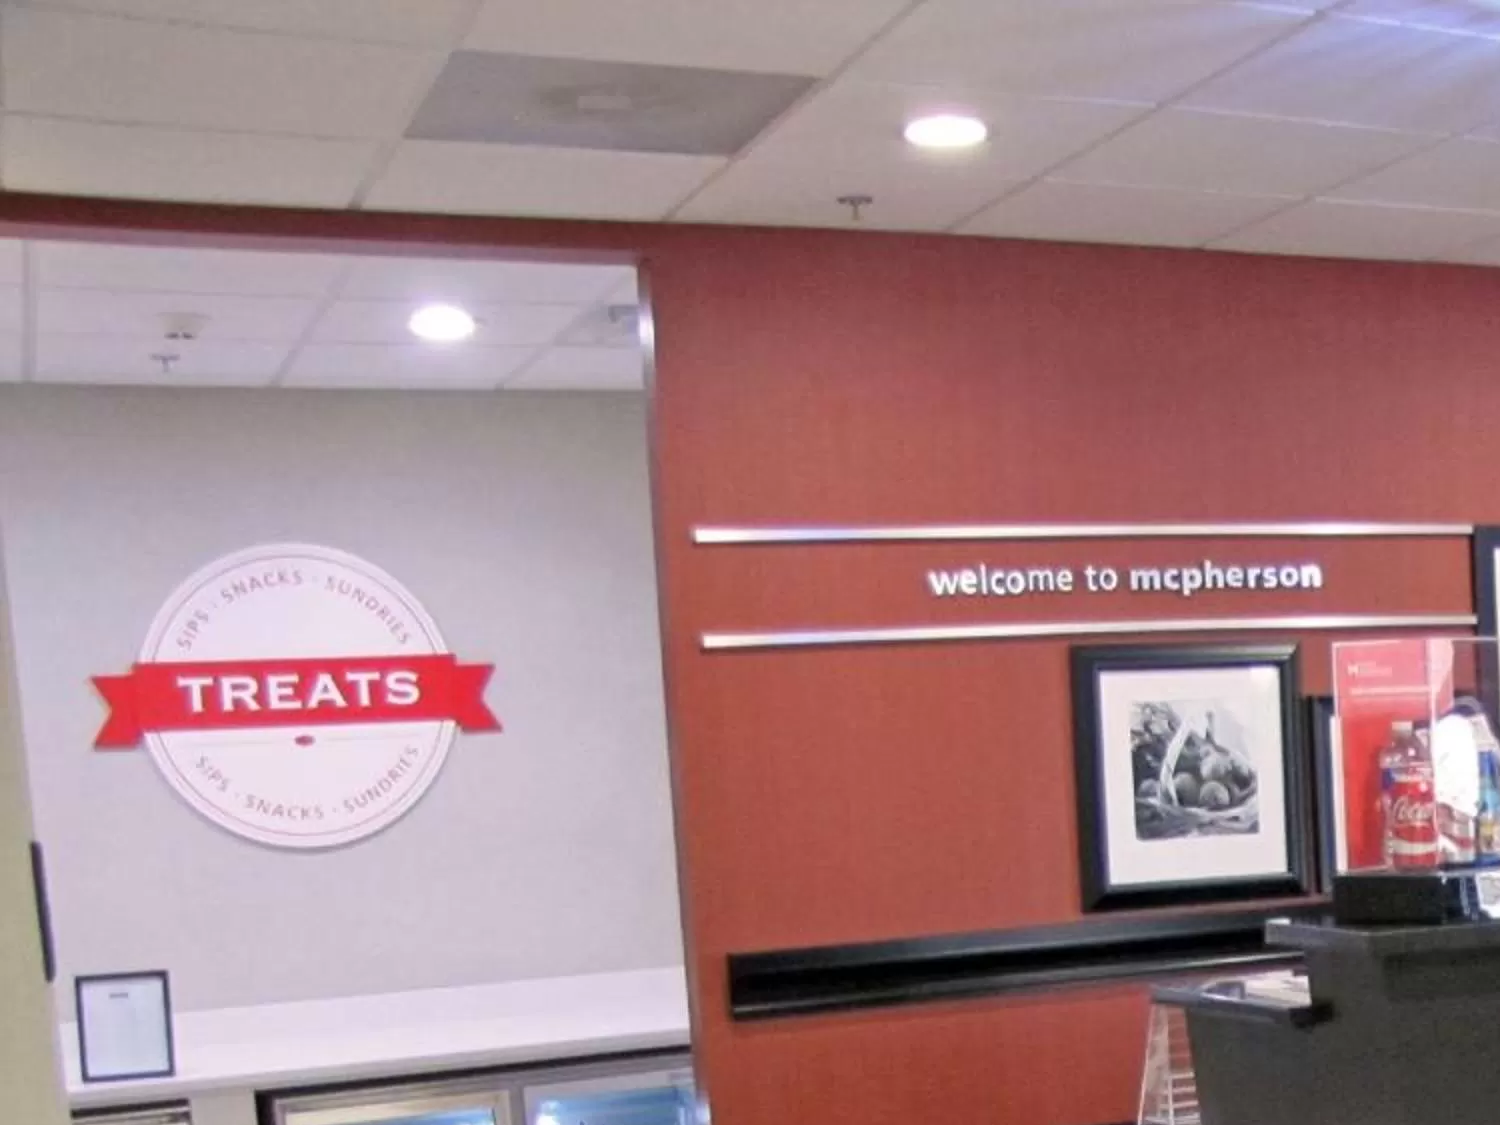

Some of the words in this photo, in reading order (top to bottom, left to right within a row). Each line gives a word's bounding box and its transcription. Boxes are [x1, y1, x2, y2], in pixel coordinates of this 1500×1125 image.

[928, 564, 1073, 596] welcome
[1085, 565, 1117, 592] to
[1130, 560, 1322, 596] mcpherson
[176, 609, 209, 651] SIPS
[220, 570, 302, 604] SNACKS
[324, 575, 410, 645] SUNDRIES
[177, 671, 420, 713] TREATS
[196, 755, 231, 793] SIPS
[246, 794, 324, 820] SNACKS
[342, 744, 419, 814] SUNDRIES
